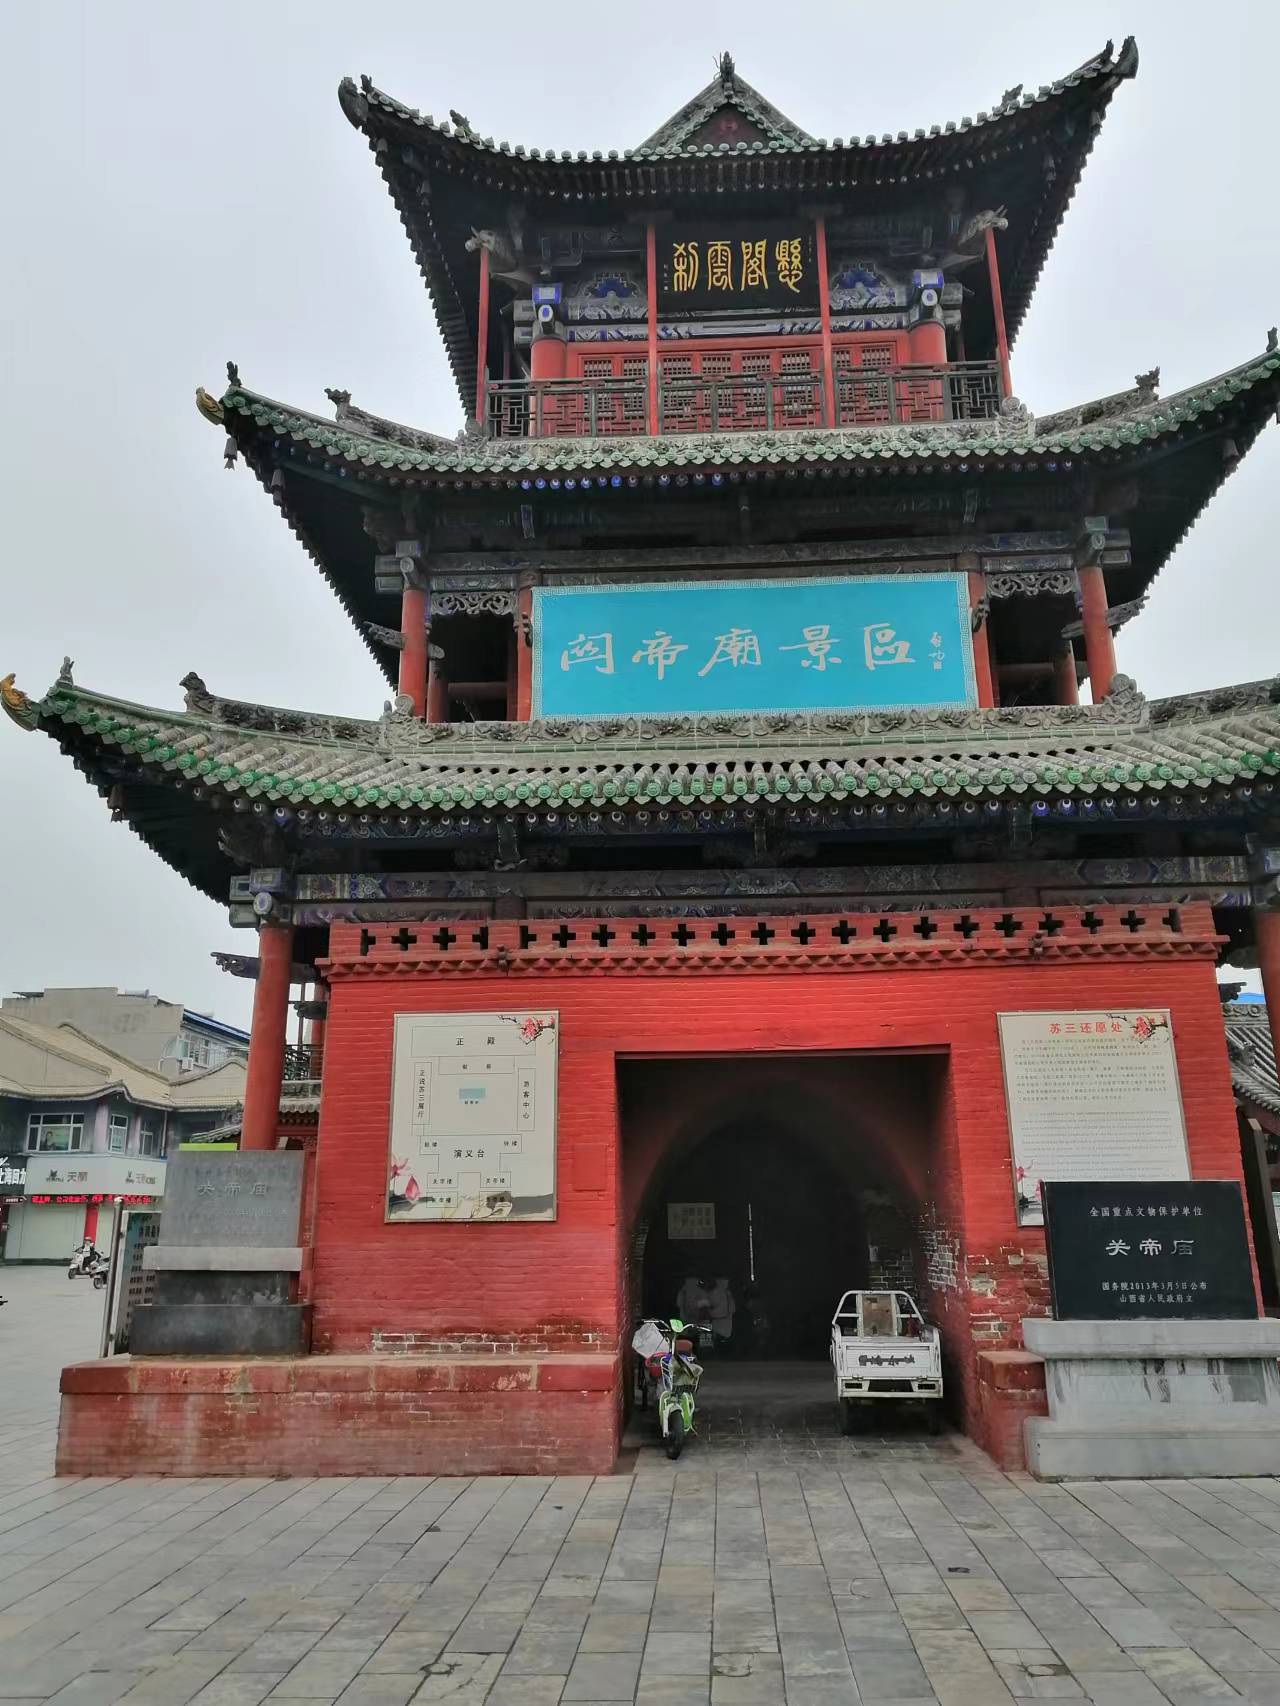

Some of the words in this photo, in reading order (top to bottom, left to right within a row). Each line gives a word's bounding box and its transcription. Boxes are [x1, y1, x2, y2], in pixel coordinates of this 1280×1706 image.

[454, 1148, 485, 1159] 演义台
[1089, 1205, 1204, 1217] 全国重点文物保护单位
[1105, 1238, 1194, 1256] 关帝庙
[1119, 1293, 1193, 1303] 山西省人民政府立
